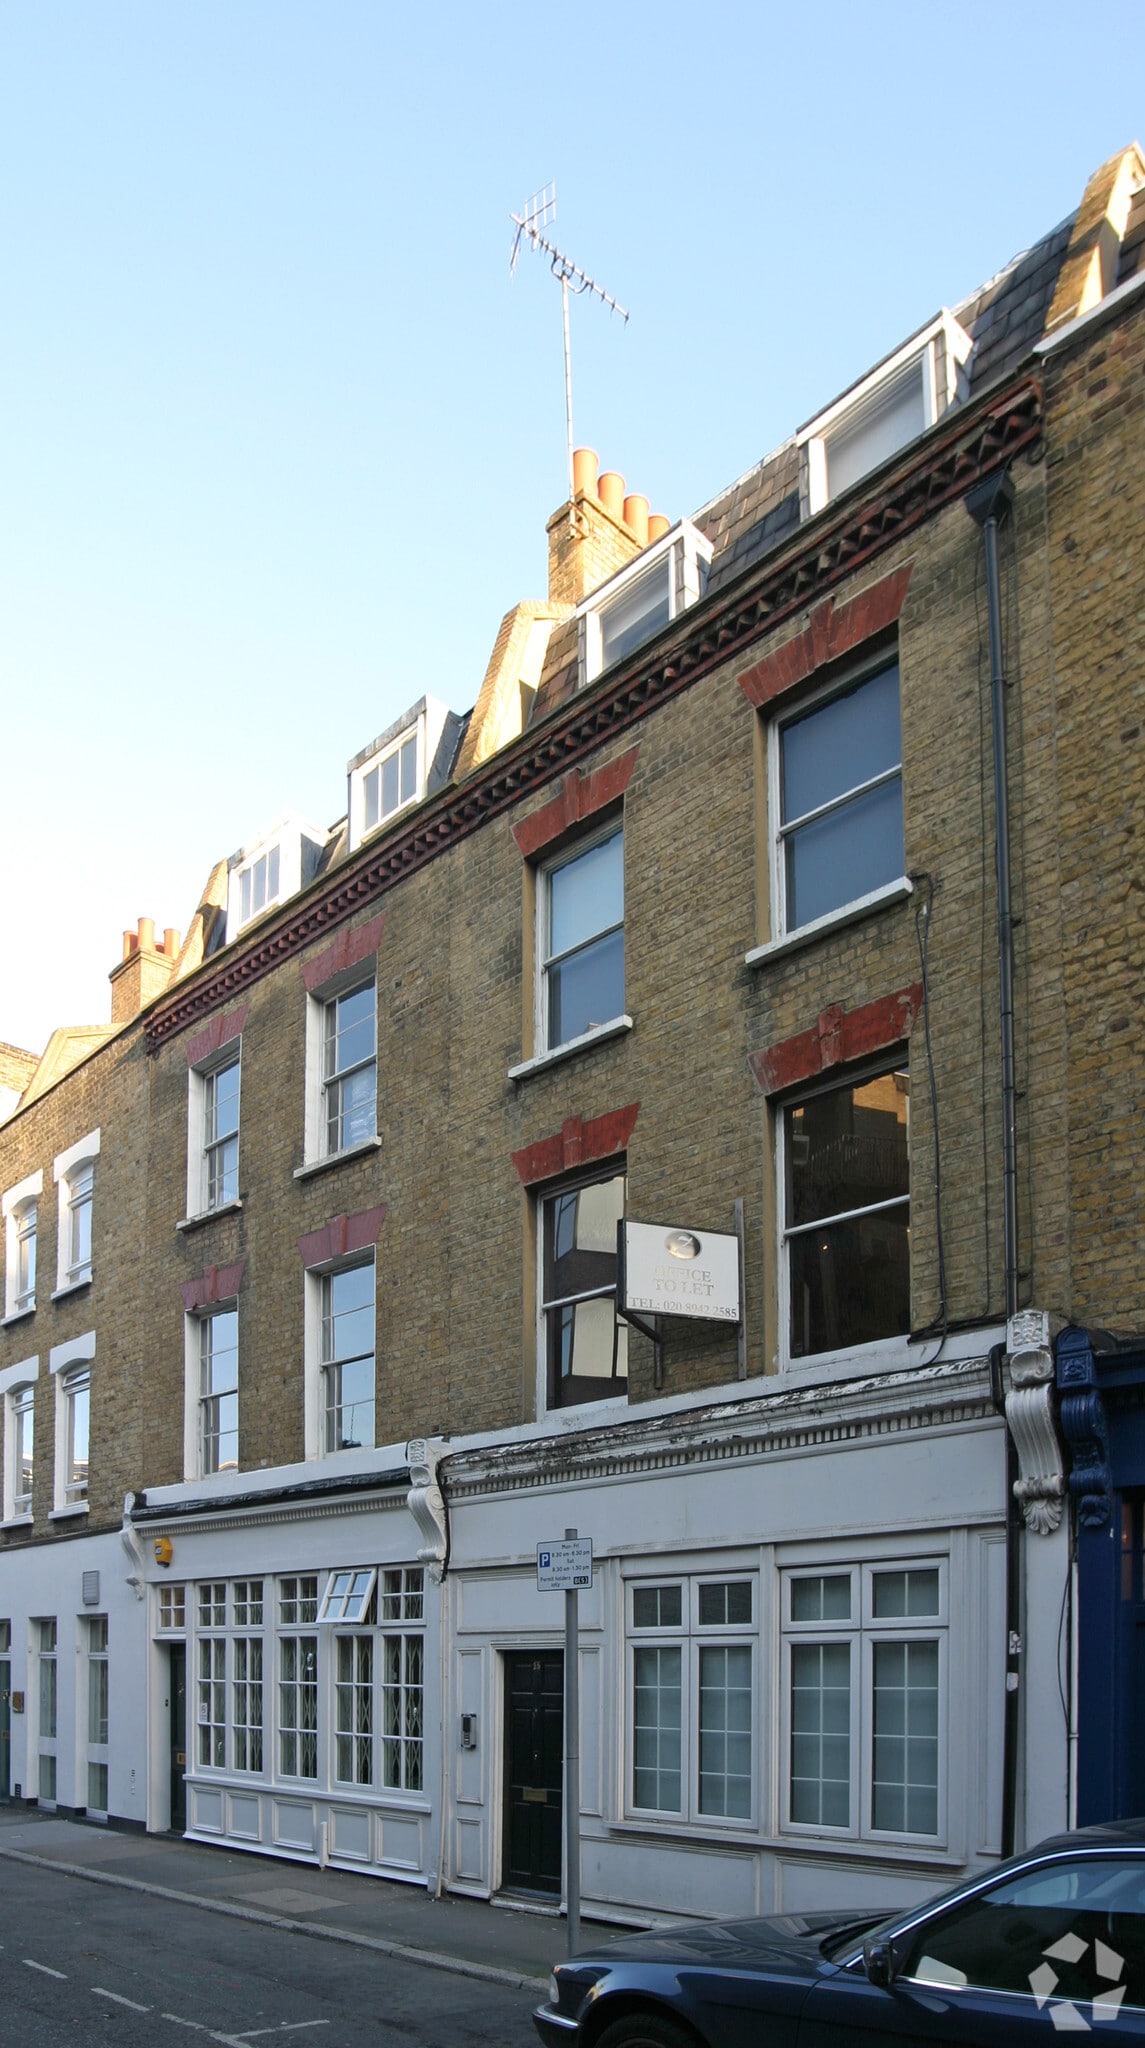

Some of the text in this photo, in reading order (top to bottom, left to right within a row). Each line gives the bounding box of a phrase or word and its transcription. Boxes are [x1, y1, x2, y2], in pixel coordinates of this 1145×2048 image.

[655, 1265, 711, 1282] OFFICE
[653, 1278, 714, 1297] TO LET
[629, 1297, 660, 1310] TEL:
[663, 1300, 682, 1311] 020
[712, 1306, 737, 1318] 2585
